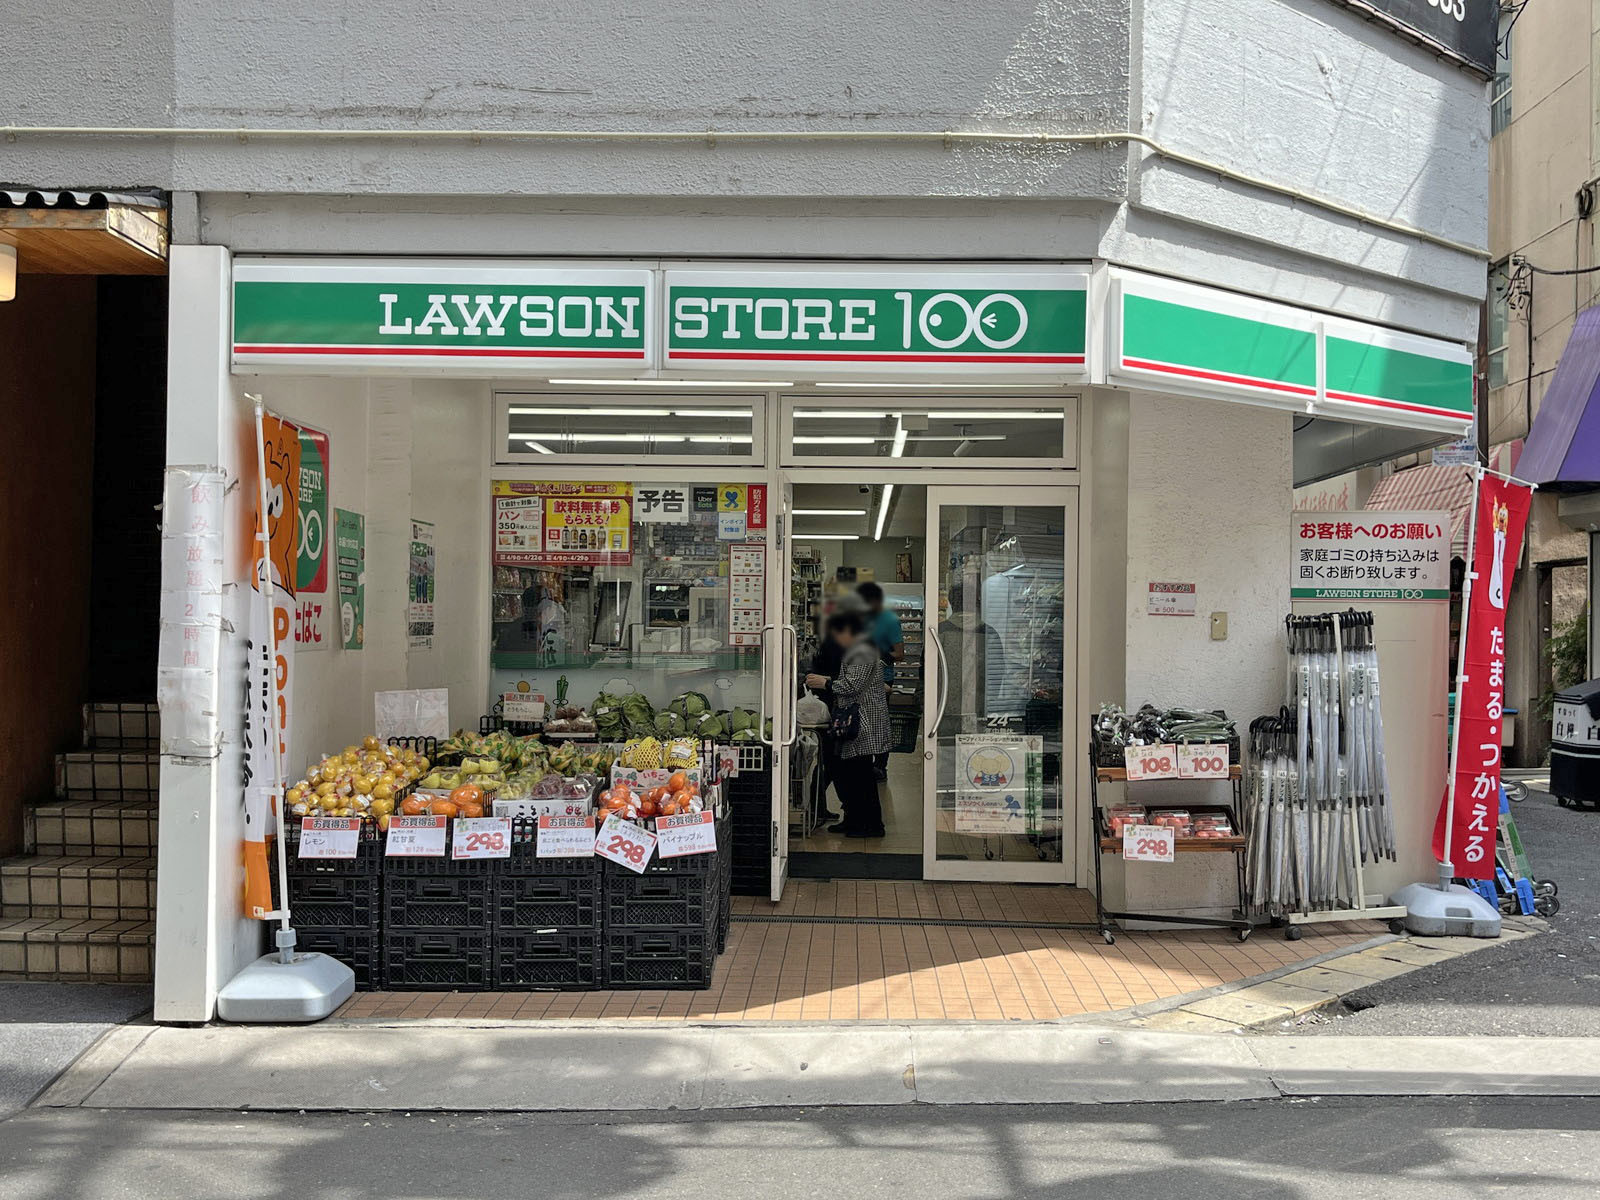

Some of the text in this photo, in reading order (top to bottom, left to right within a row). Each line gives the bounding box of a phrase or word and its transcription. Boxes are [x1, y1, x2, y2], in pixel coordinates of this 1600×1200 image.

[379, 291, 1029, 350] LAWSON STORE 100
[299, 467, 322, 490] SON
[553, 500, 621, 514] 飲料無料券
[638, 490, 685, 513] 予告
[498, 510, 521, 521] パン
[564, 515, 610, 525] もらえる!
[1299, 522, 1442, 540] お客様へのお願い
[1300, 548, 1440, 562] 家庭ゴミの持ち込みは
[183, 487, 211, 666] 飲み放題2時間
[1300, 565, 1428, 579] 固くお断り致します。
[1316, 589, 1424, 599] LAWSON STORE 100
[987, 712, 1010, 727] 24
[1464, 626, 1504, 863] たまる・つかえる
[1139, 756, 1172, 774] 108
[1191, 757, 1224, 773] 100
[313, 819, 350, 829] お買得品
[400, 817, 437, 827] お買得品
[549, 818, 586, 827] お買得品
[666, 814, 703, 827] お買得品
[466, 832, 505, 852] 298
[663, 832, 704, 844] パイナップル
[607, 834, 646, 864] 298
[1136, 837, 1168, 856] 298
